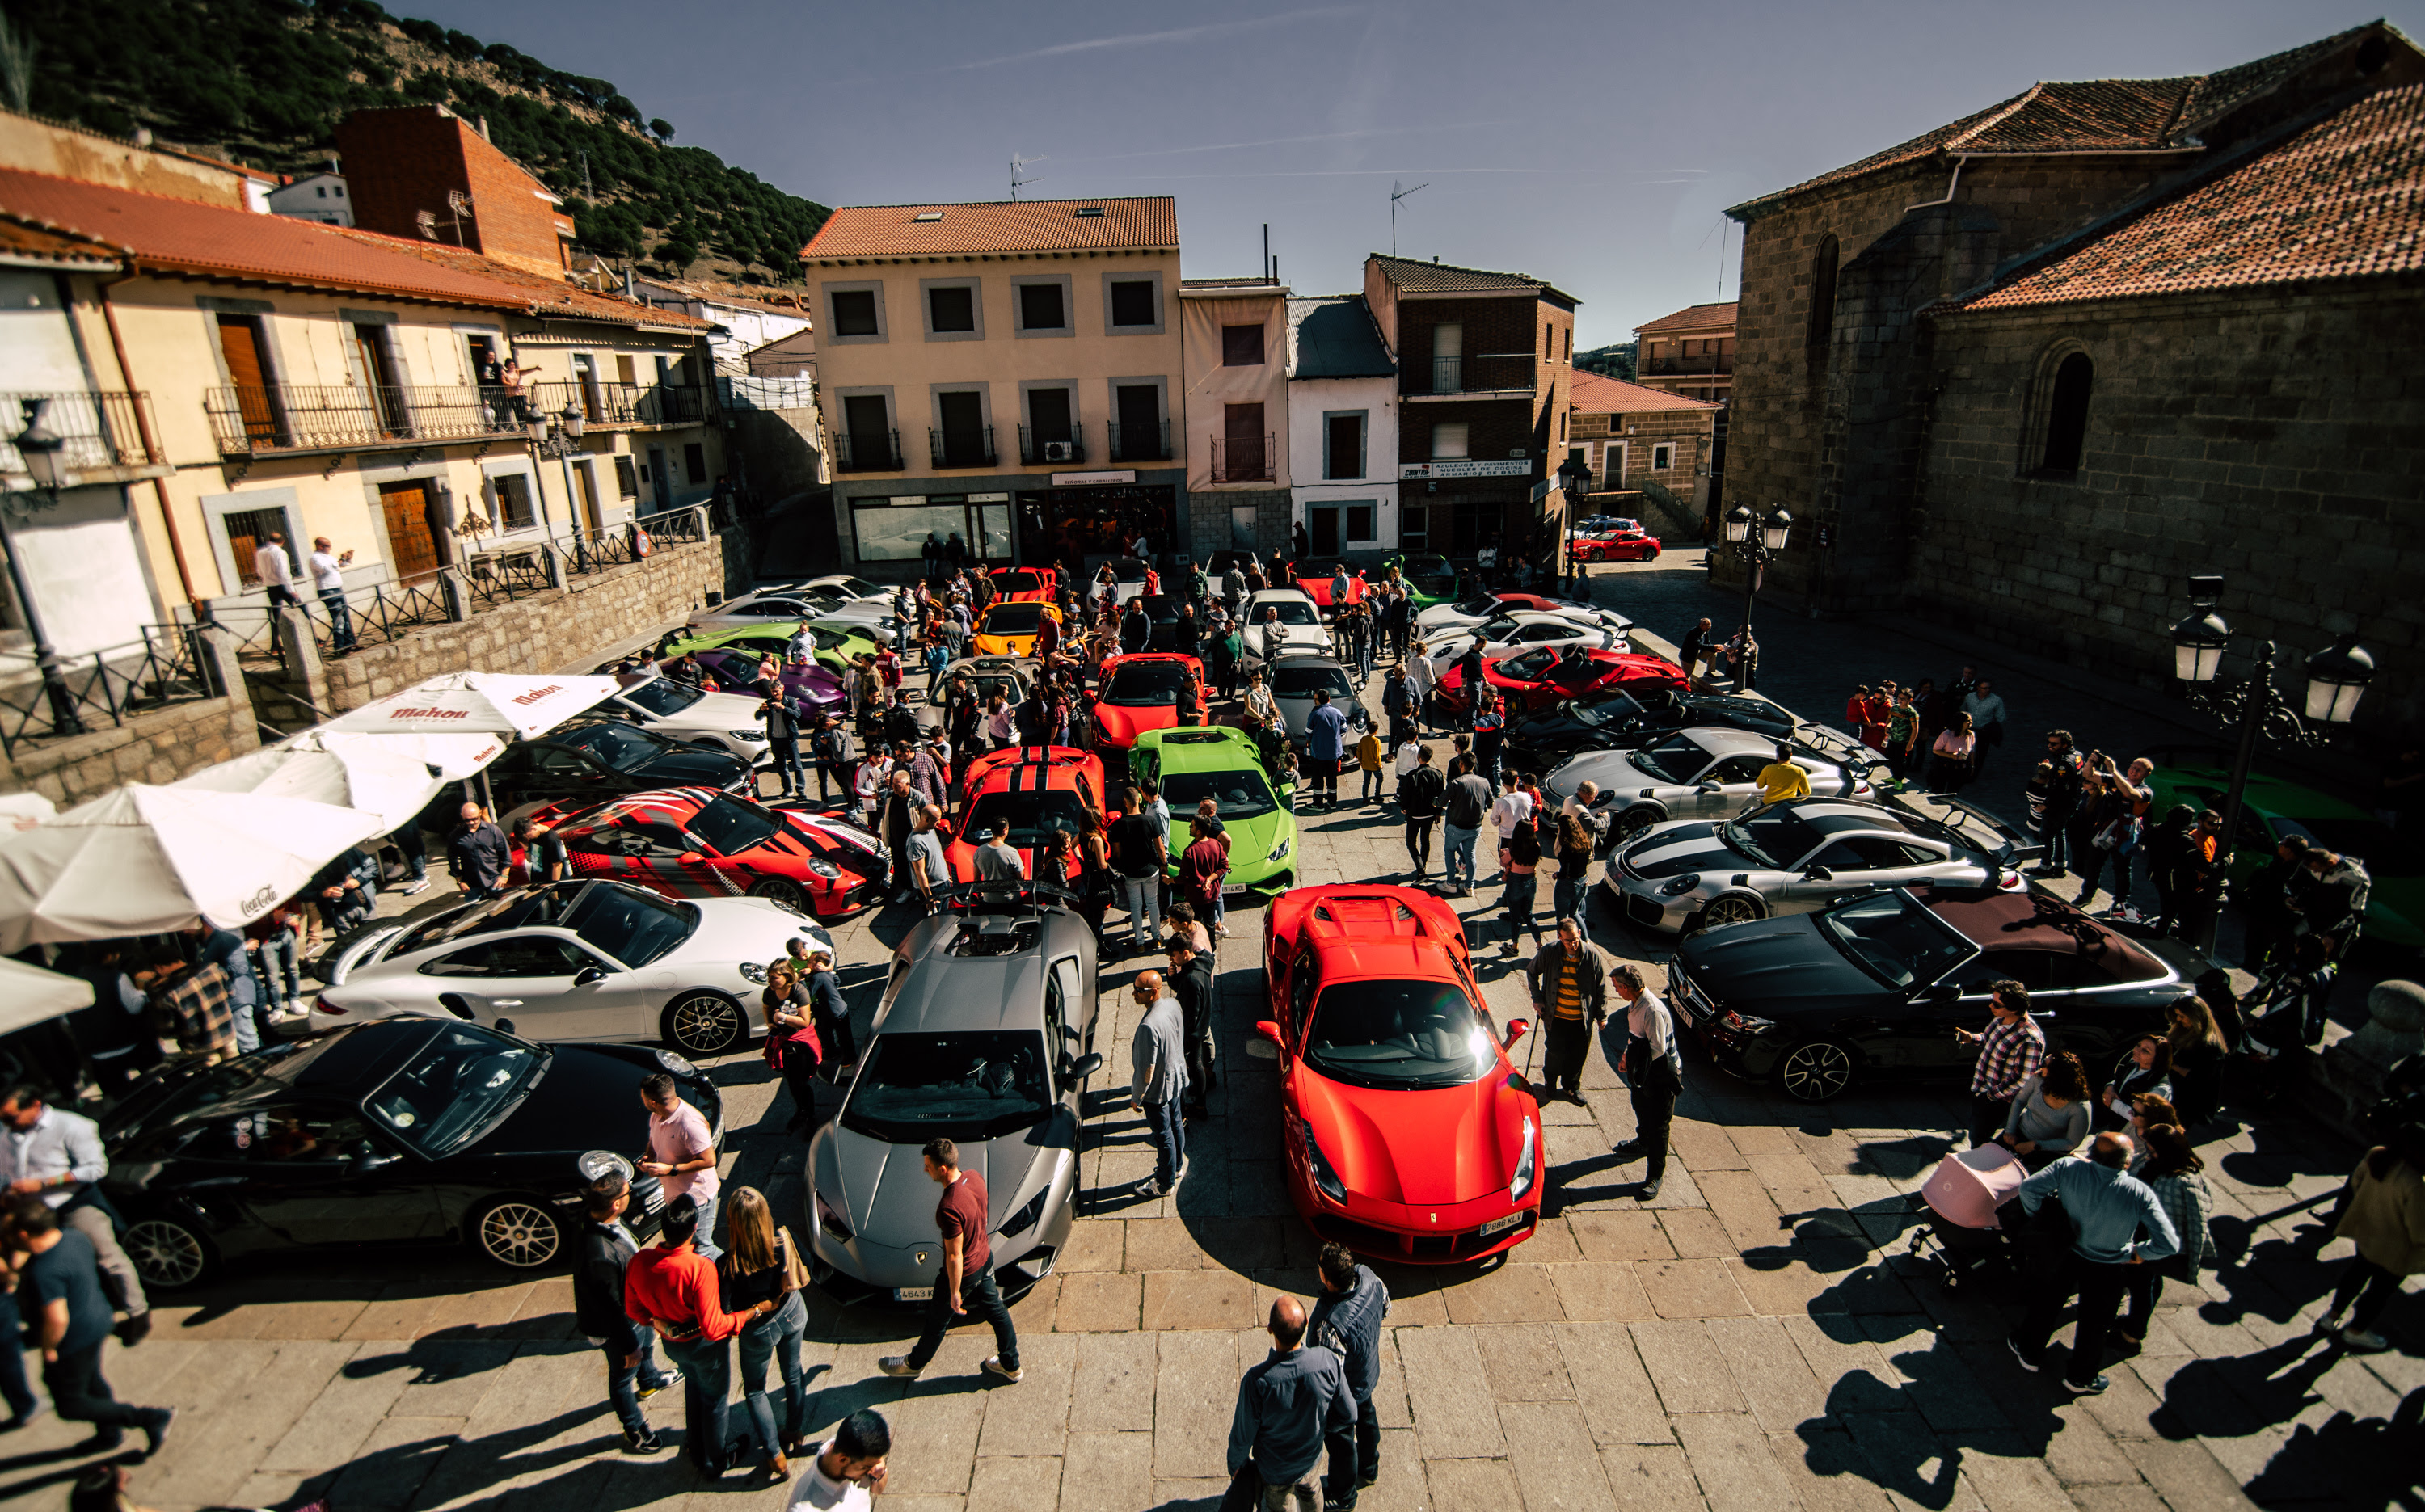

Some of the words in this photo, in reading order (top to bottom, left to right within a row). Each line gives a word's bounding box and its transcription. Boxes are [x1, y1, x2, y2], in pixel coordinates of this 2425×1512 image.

[512, 684, 563, 705] Mahou
[390, 707, 470, 718] Mahou
[474, 745, 497, 762] Mahou
[1487, 1219, 1507, 1232] 7886
[902, 1290, 926, 1298] 4643
